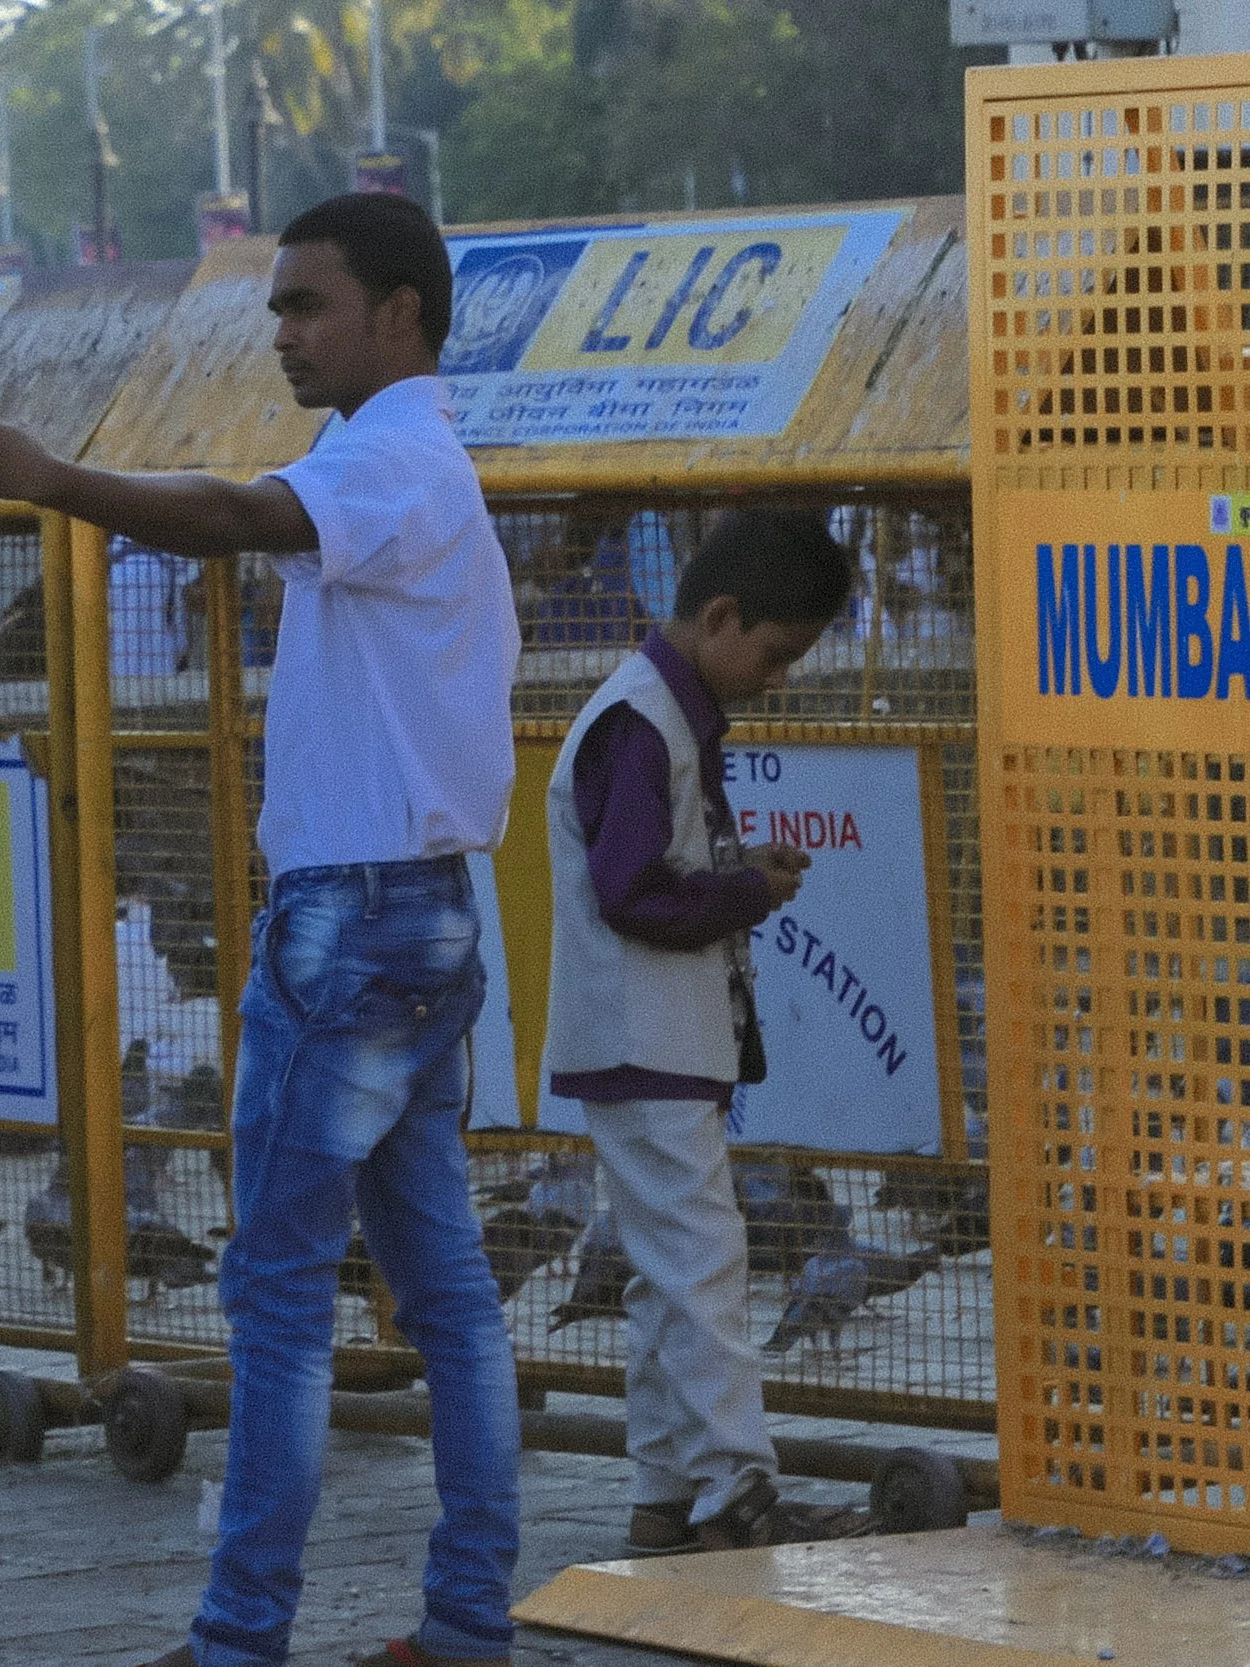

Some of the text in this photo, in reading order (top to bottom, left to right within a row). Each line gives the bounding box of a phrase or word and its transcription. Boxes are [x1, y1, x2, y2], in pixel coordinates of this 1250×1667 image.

[580, 242, 783, 351] LIC
[513, 421, 647, 437] CORPORATION
[685, 418, 739, 431] INDIA
[746, 751, 781, 782] TO
[769, 810, 862, 848] INDIA
[776, 916, 907, 1076] STATION
